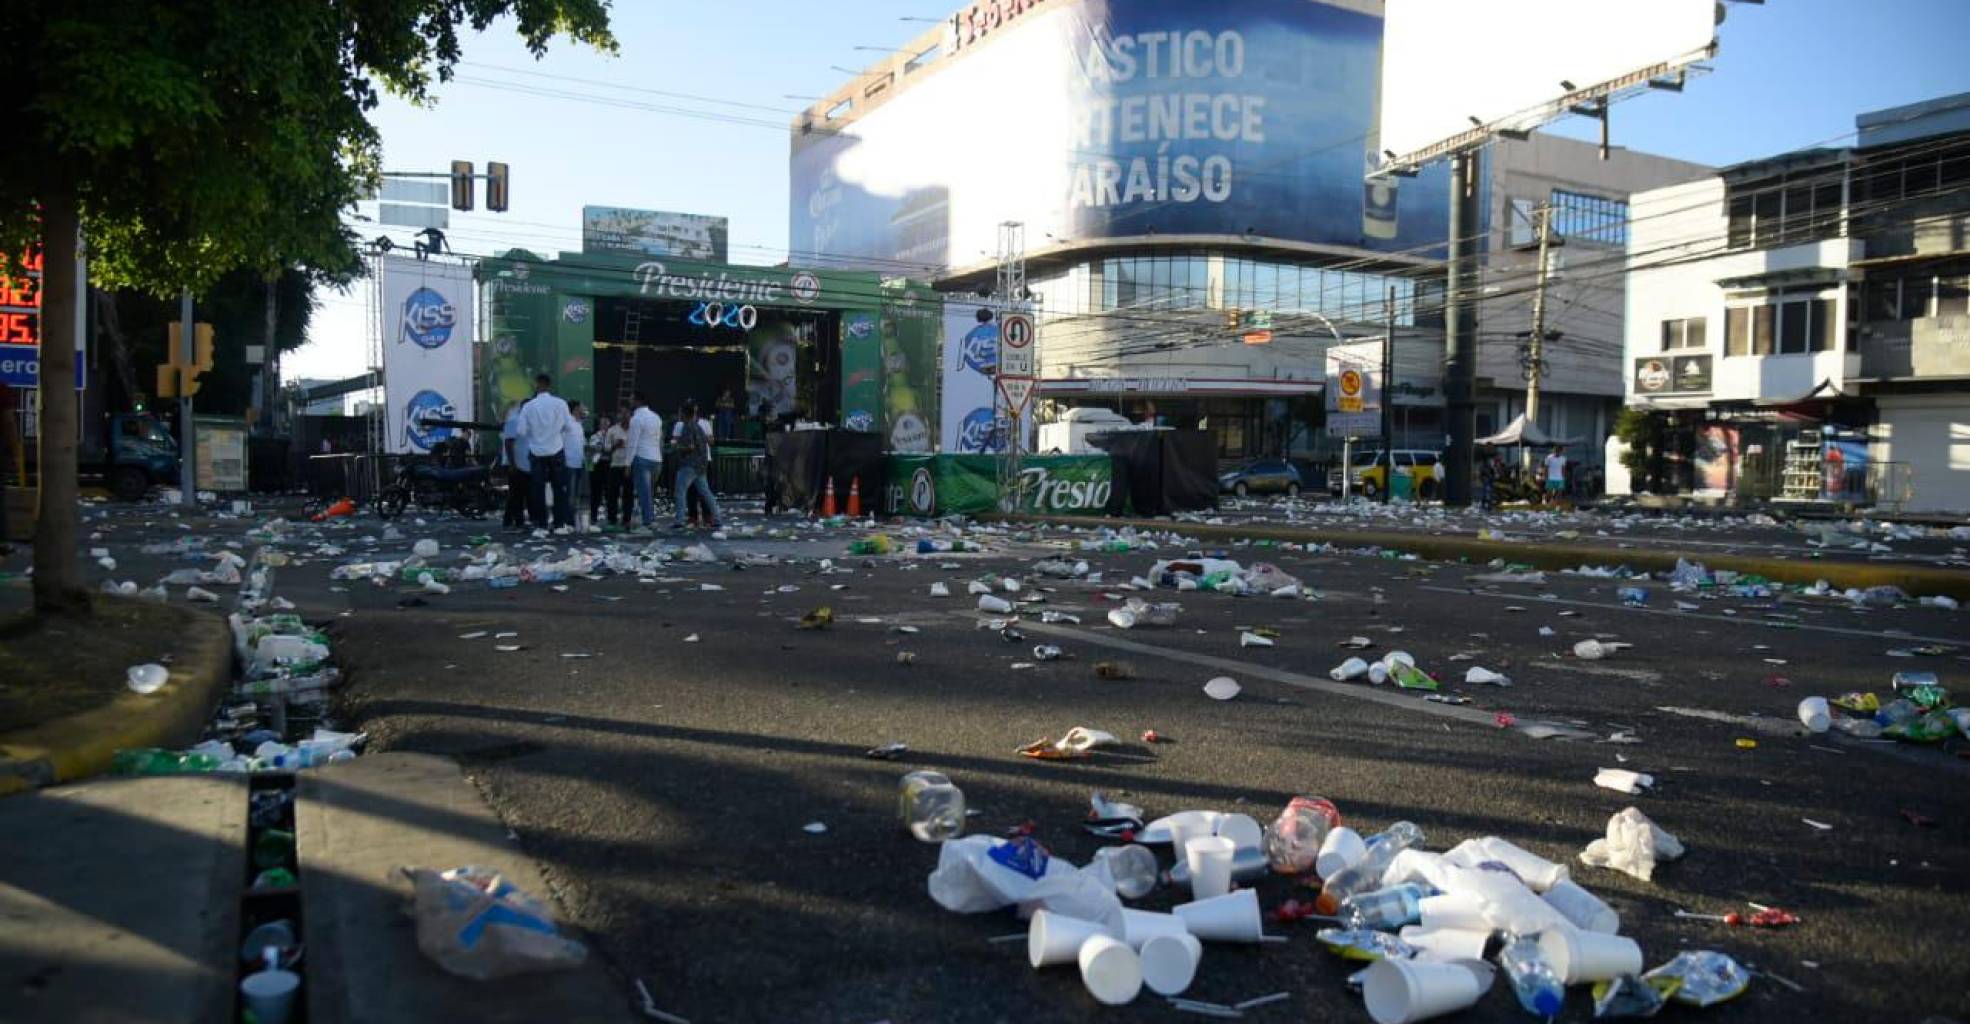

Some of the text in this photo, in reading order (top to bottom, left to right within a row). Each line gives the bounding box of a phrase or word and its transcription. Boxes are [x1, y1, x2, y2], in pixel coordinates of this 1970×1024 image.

[633, 262, 783, 301] Presidente
[398, 302, 457, 344] KISS
[688, 301, 758, 328] 2020
